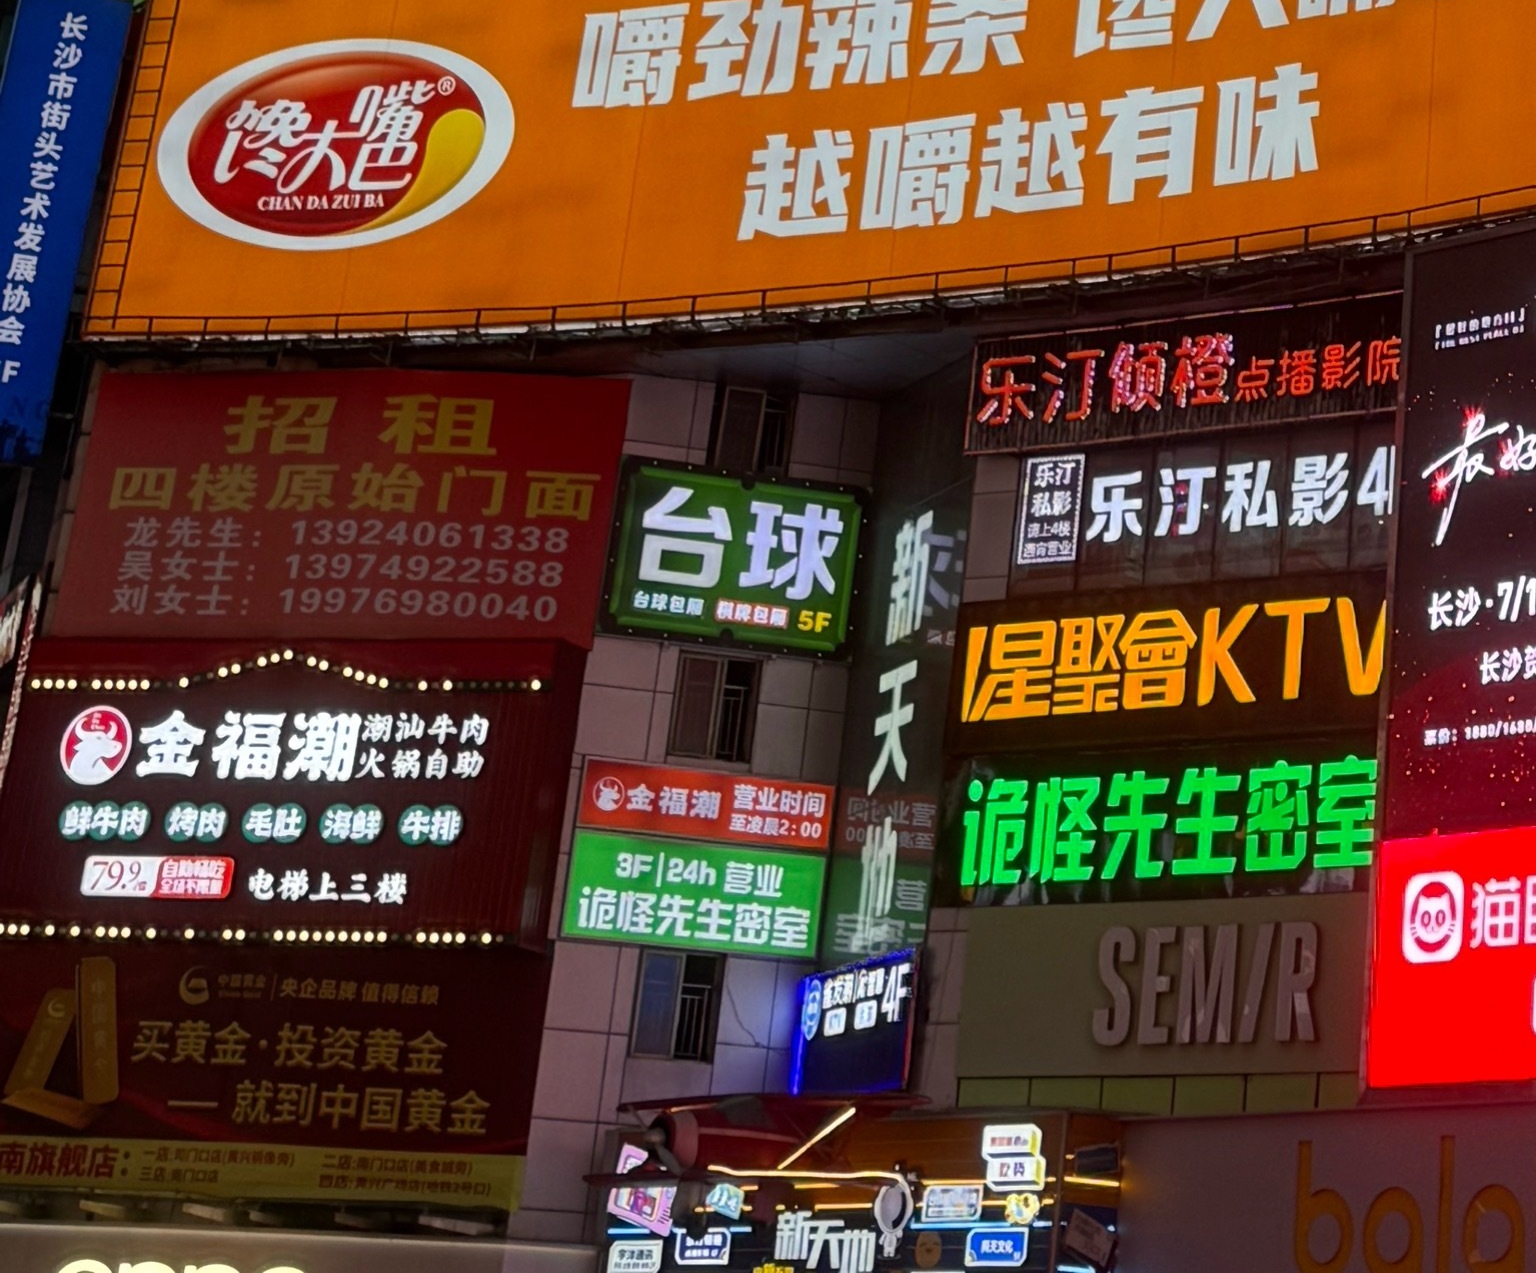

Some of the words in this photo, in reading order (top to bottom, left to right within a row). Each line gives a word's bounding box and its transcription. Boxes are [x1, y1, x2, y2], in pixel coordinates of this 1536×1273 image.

[213, 80, 438, 194] 馋大嘴巴
[736, 61, 1321, 242] 越嚼越有味
[0, 12, 89, 345] 长沙市街头艺术发展协会
[257, 193, 304, 211] CHAN
[305, 193, 330, 210] DA
[331, 193, 362, 209] ZUI
[362, 192, 385, 209] BA
[0, 360, 20, 384] F
[223, 394, 498, 458] 招租
[108, 463, 601, 522] 四楼原始门面
[1034, 462, 1077, 488] 乐汀
[1030, 490, 1072, 517] 私影
[1086, 445, 1396, 544] 乐汀私影4
[290, 518, 570, 553] 13924061338
[638, 486, 844, 600] 台球
[284, 553, 564, 588] 13974922588
[278, 587, 558, 623] 19976980040
[633, 591, 705, 616] 台球包厢
[797, 611, 832, 633] 5F
[961, 597, 1388, 723] 星聚會KTV
[135, 710, 361, 782] 金福潮
[361, 713, 489, 744] 潮汕牛肉
[356, 747, 485, 780] 火锅自助
[626, 783, 722, 820] 金福潮
[733, 784, 827, 818] 营业时间
[64, 806, 149, 839] 鲜牛肉
[167, 807, 226, 839] 烤肉
[245, 808, 303, 840] 毛肚
[322, 809, 382, 841] 海鲜
[400, 811, 461, 843] 牛排
[961, 754, 1378, 887] 诡怪先生密室
[247, 868, 408, 905] 电梯上三楼
[723, 862, 784, 899] 营业
[577, 886, 810, 949] 诡怪先生密室
[279, 977, 357, 1003] 央企品牌
[1092, 921, 1319, 1046] SEMIR
[131, 1020, 448, 1076] 买黄金·投资黄金
[232, 1079, 490, 1136] 就到中国黄金
